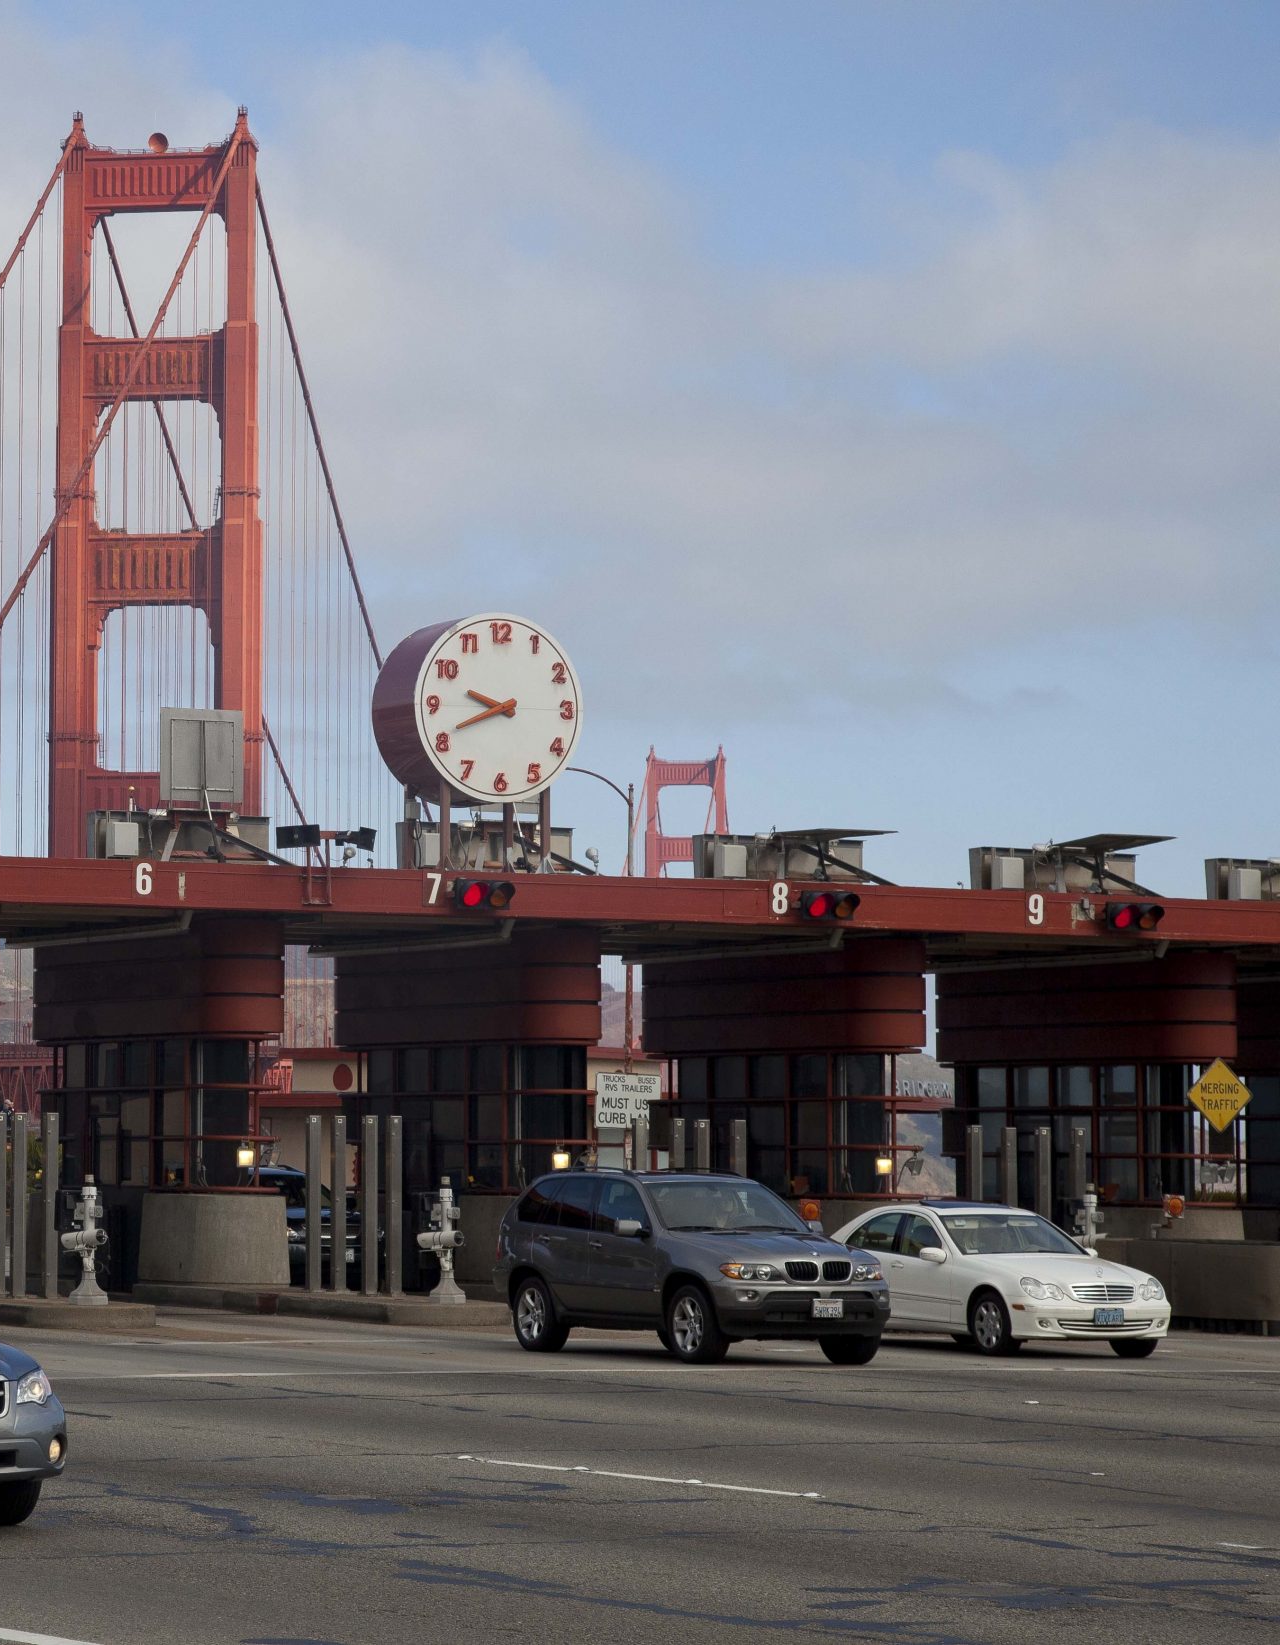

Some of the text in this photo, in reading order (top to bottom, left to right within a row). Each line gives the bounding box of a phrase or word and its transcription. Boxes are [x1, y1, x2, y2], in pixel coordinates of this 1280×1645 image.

[490, 622, 512, 643] 12
[460, 633, 479, 653] 11
[529, 635, 540, 654] 1
[435, 659, 459, 680] 10
[552, 662, 567, 684] 2
[426, 695, 440, 714] 9
[560, 700, 574, 720] 3
[436, 732, 450, 752] 8
[550, 737, 564, 756] 4
[460, 759, 474, 781] 7
[527, 763, 541, 784] 5
[493, 773, 507, 792] 6
[136, 862, 153, 895] 6
[426, 872, 442, 904] 7
[772, 882, 789, 915] 8
[1028, 893, 1044, 925] 9
[602, 1075, 626, 1083] TRUCKS
[621, 1084, 653, 1093] TRAILERS
[1200, 1083, 1239, 1094] MERGING
[601, 1097, 649, 1110] MUST US
[1202, 1099, 1239, 1110] TRAFFIC
[598, 1112, 627, 1124] CURB
